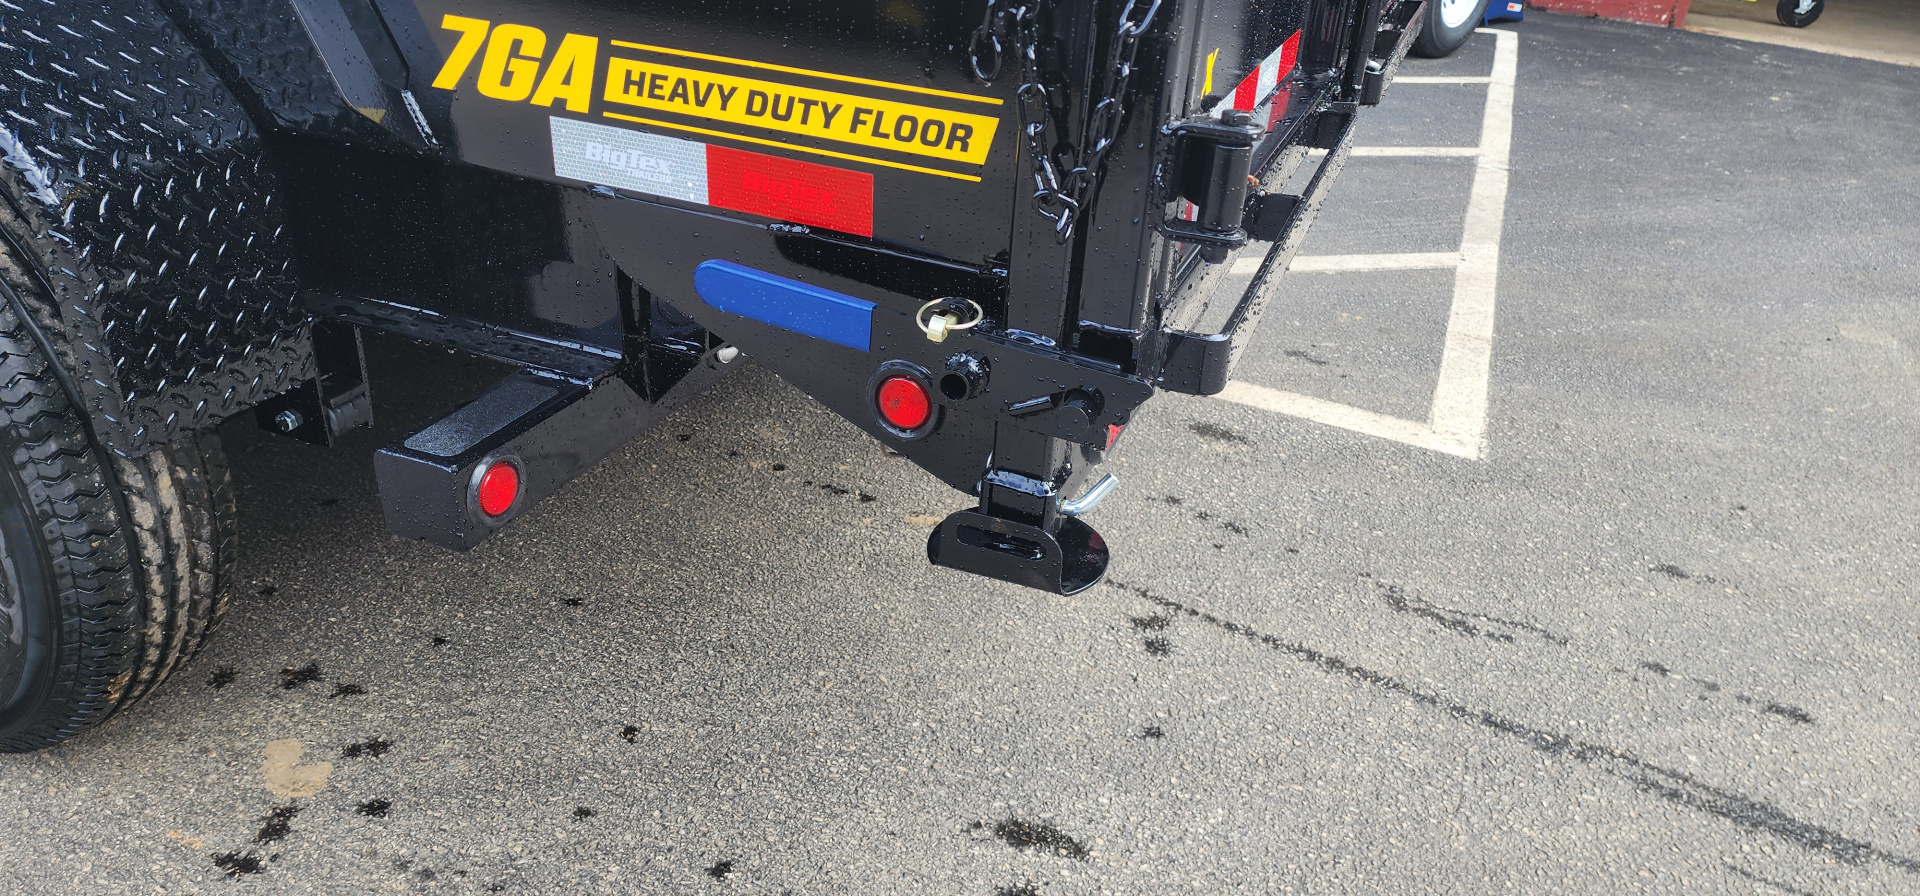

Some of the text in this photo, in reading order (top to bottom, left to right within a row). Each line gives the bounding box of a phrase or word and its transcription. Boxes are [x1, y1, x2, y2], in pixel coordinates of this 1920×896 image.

[432, 14, 974, 153] 7GA HEAVY DUTY FLOOR
[584, 140, 672, 176] BigTex
